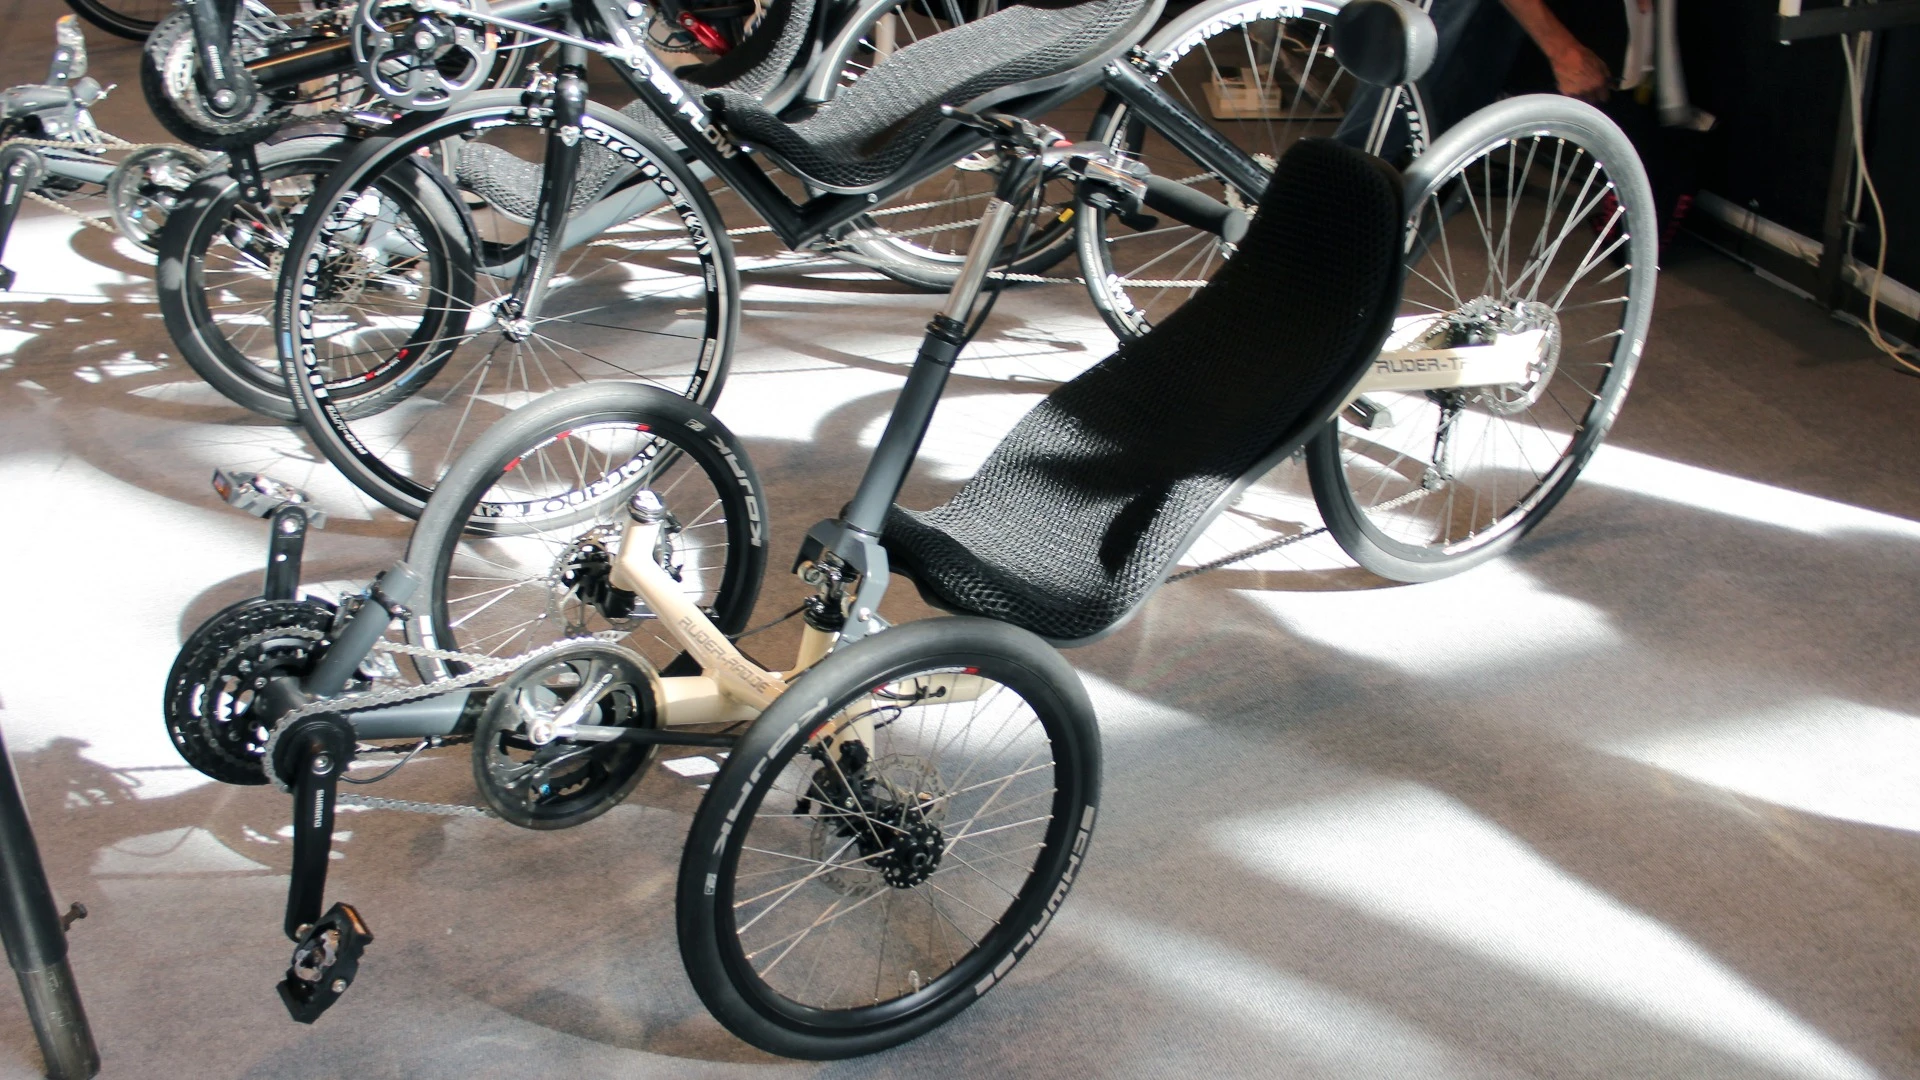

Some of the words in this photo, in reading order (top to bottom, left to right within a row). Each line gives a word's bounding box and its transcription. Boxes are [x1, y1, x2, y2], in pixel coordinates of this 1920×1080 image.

[582, 126, 679, 197] erano
[680, 102, 738, 159] FLOW
[709, 434, 762, 546] KOJAK
[713, 697, 828, 855] KOJAK
[974, 806, 1096, 996] SCHWALBE
